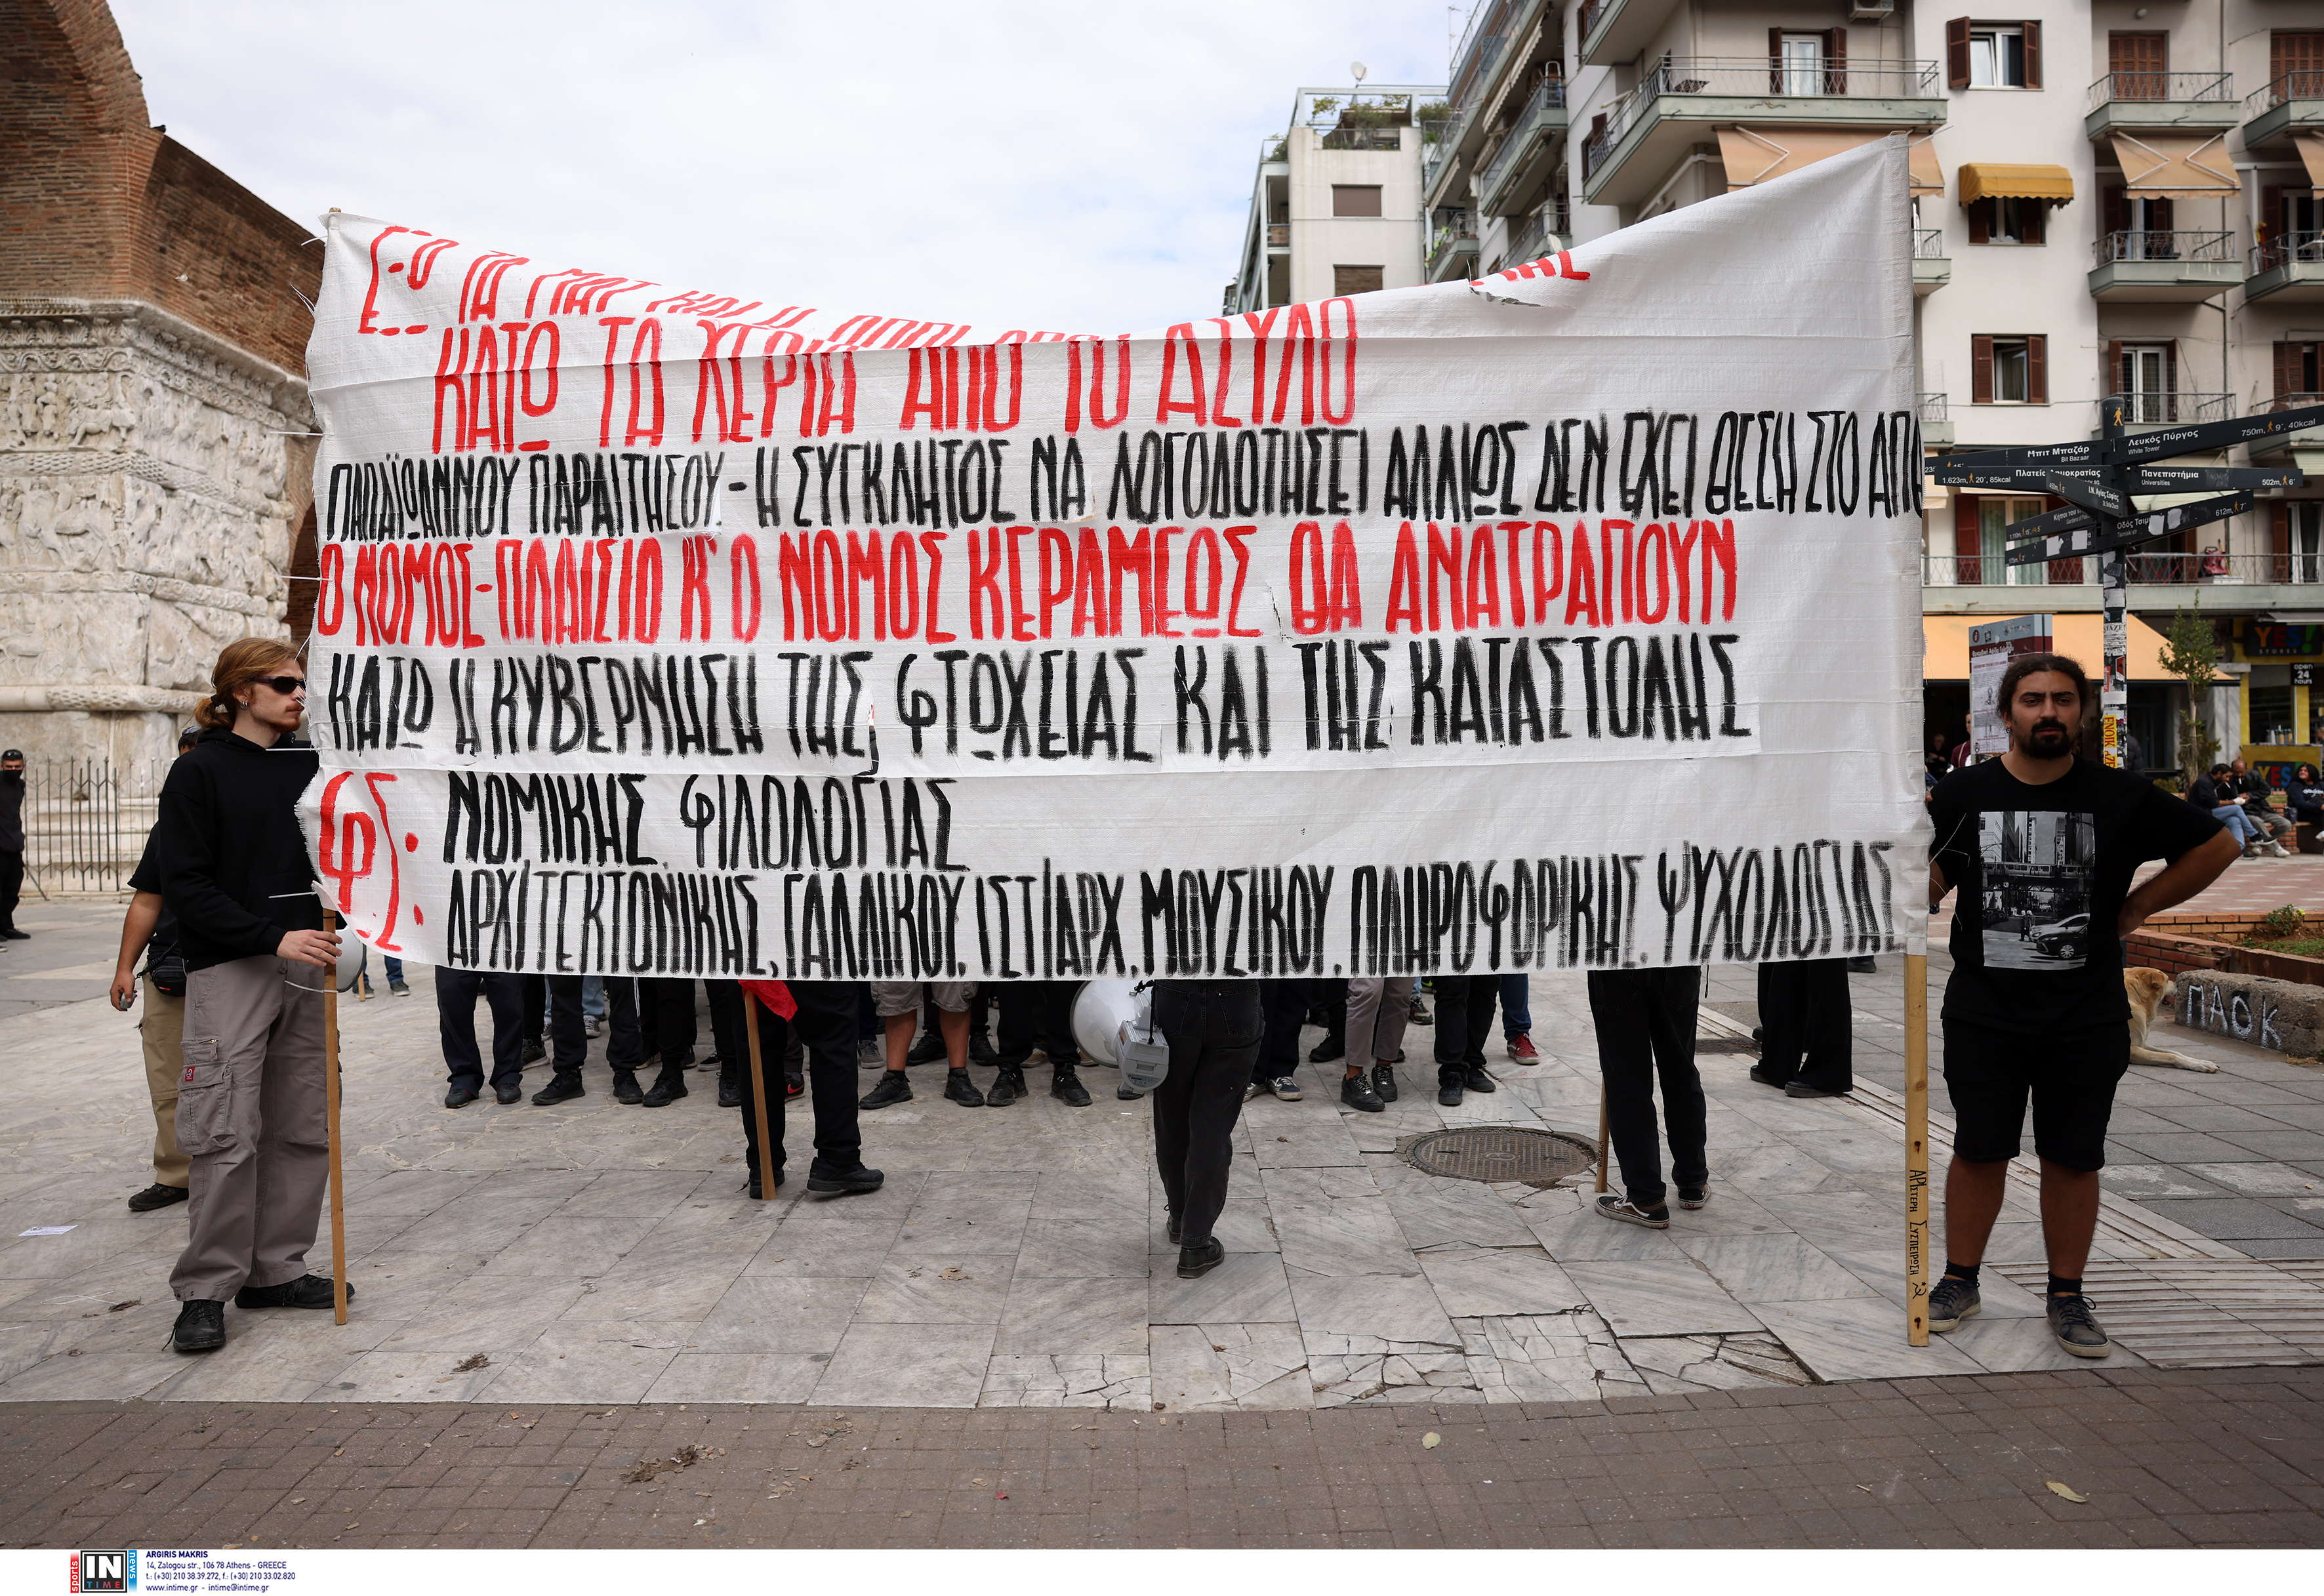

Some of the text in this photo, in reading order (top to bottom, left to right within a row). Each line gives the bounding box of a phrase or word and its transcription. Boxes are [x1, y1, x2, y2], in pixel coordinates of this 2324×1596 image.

[432, 316, 560, 455] ΚΑΤΩ
[599, 316, 664, 449] ΤΑ
[1156, 297, 1358, 428] ΑΣΥΛΟ
[2288, 418, 2315, 428] 40kcal
[2128, 429, 2199, 447] Λευκός Πύργος
[2052, 445, 2090, 456] Μπαζάρ
[792, 439, 1016, 530] ΣΥΓΚΛΗΤΟΣ
[1031, 435, 1085, 522] ΝΑ
[1107, 428, 1368, 524] ΛΟΓΟΔΟΤΗΣΕΙ
[1384, 420, 1528, 522] ΑΛΛΙΩΣ
[1534, 416, 1608, 513] ΔΕΝ
[1705, 411, 1797, 515] ΘΕΣΗ
[1805, 411, 1860, 516] ΣΤΟ
[2050, 468, 2101, 478] μοκρατίας
[2141, 470, 2199, 479] Πανεπιστήμια
[2117, 517, 2150, 529] Οδός Τσιμ
[318, 544, 344, 636] Ο
[730, 533, 762, 644] Ο
[778, 529, 957, 645] ΝΟΜΟΣ
[968, 525, 1263, 642] ΚΕΡΑΜΕΩΣ
[1289, 518, 1362, 636] ΘΑ
[1386, 518, 1738, 634] ΑΝΑΤΡΑΠΟΥΝ
[2296, 670, 2310, 679] 24
[329, 653, 433, 757] ΚΑΤΩ
[450, 659, 481, 756] Η
[491, 653, 764, 756] ΚΥΒΕΡΝΗΣΗ
[777, 651, 874, 758] ΤΗΣ
[1174, 645, 1271, 760] ΚΑΙ
[1292, 640, 1391, 752] ΤΗΣ
[1409, 632, 1751, 746] ΚΑΤΑΣΤΟΛΗΣ
[1909, 1169, 1927, 1276] ΑΡΙΣΤΕΡΗ ΣΥΣΠΕΙΡΩΣΗ
